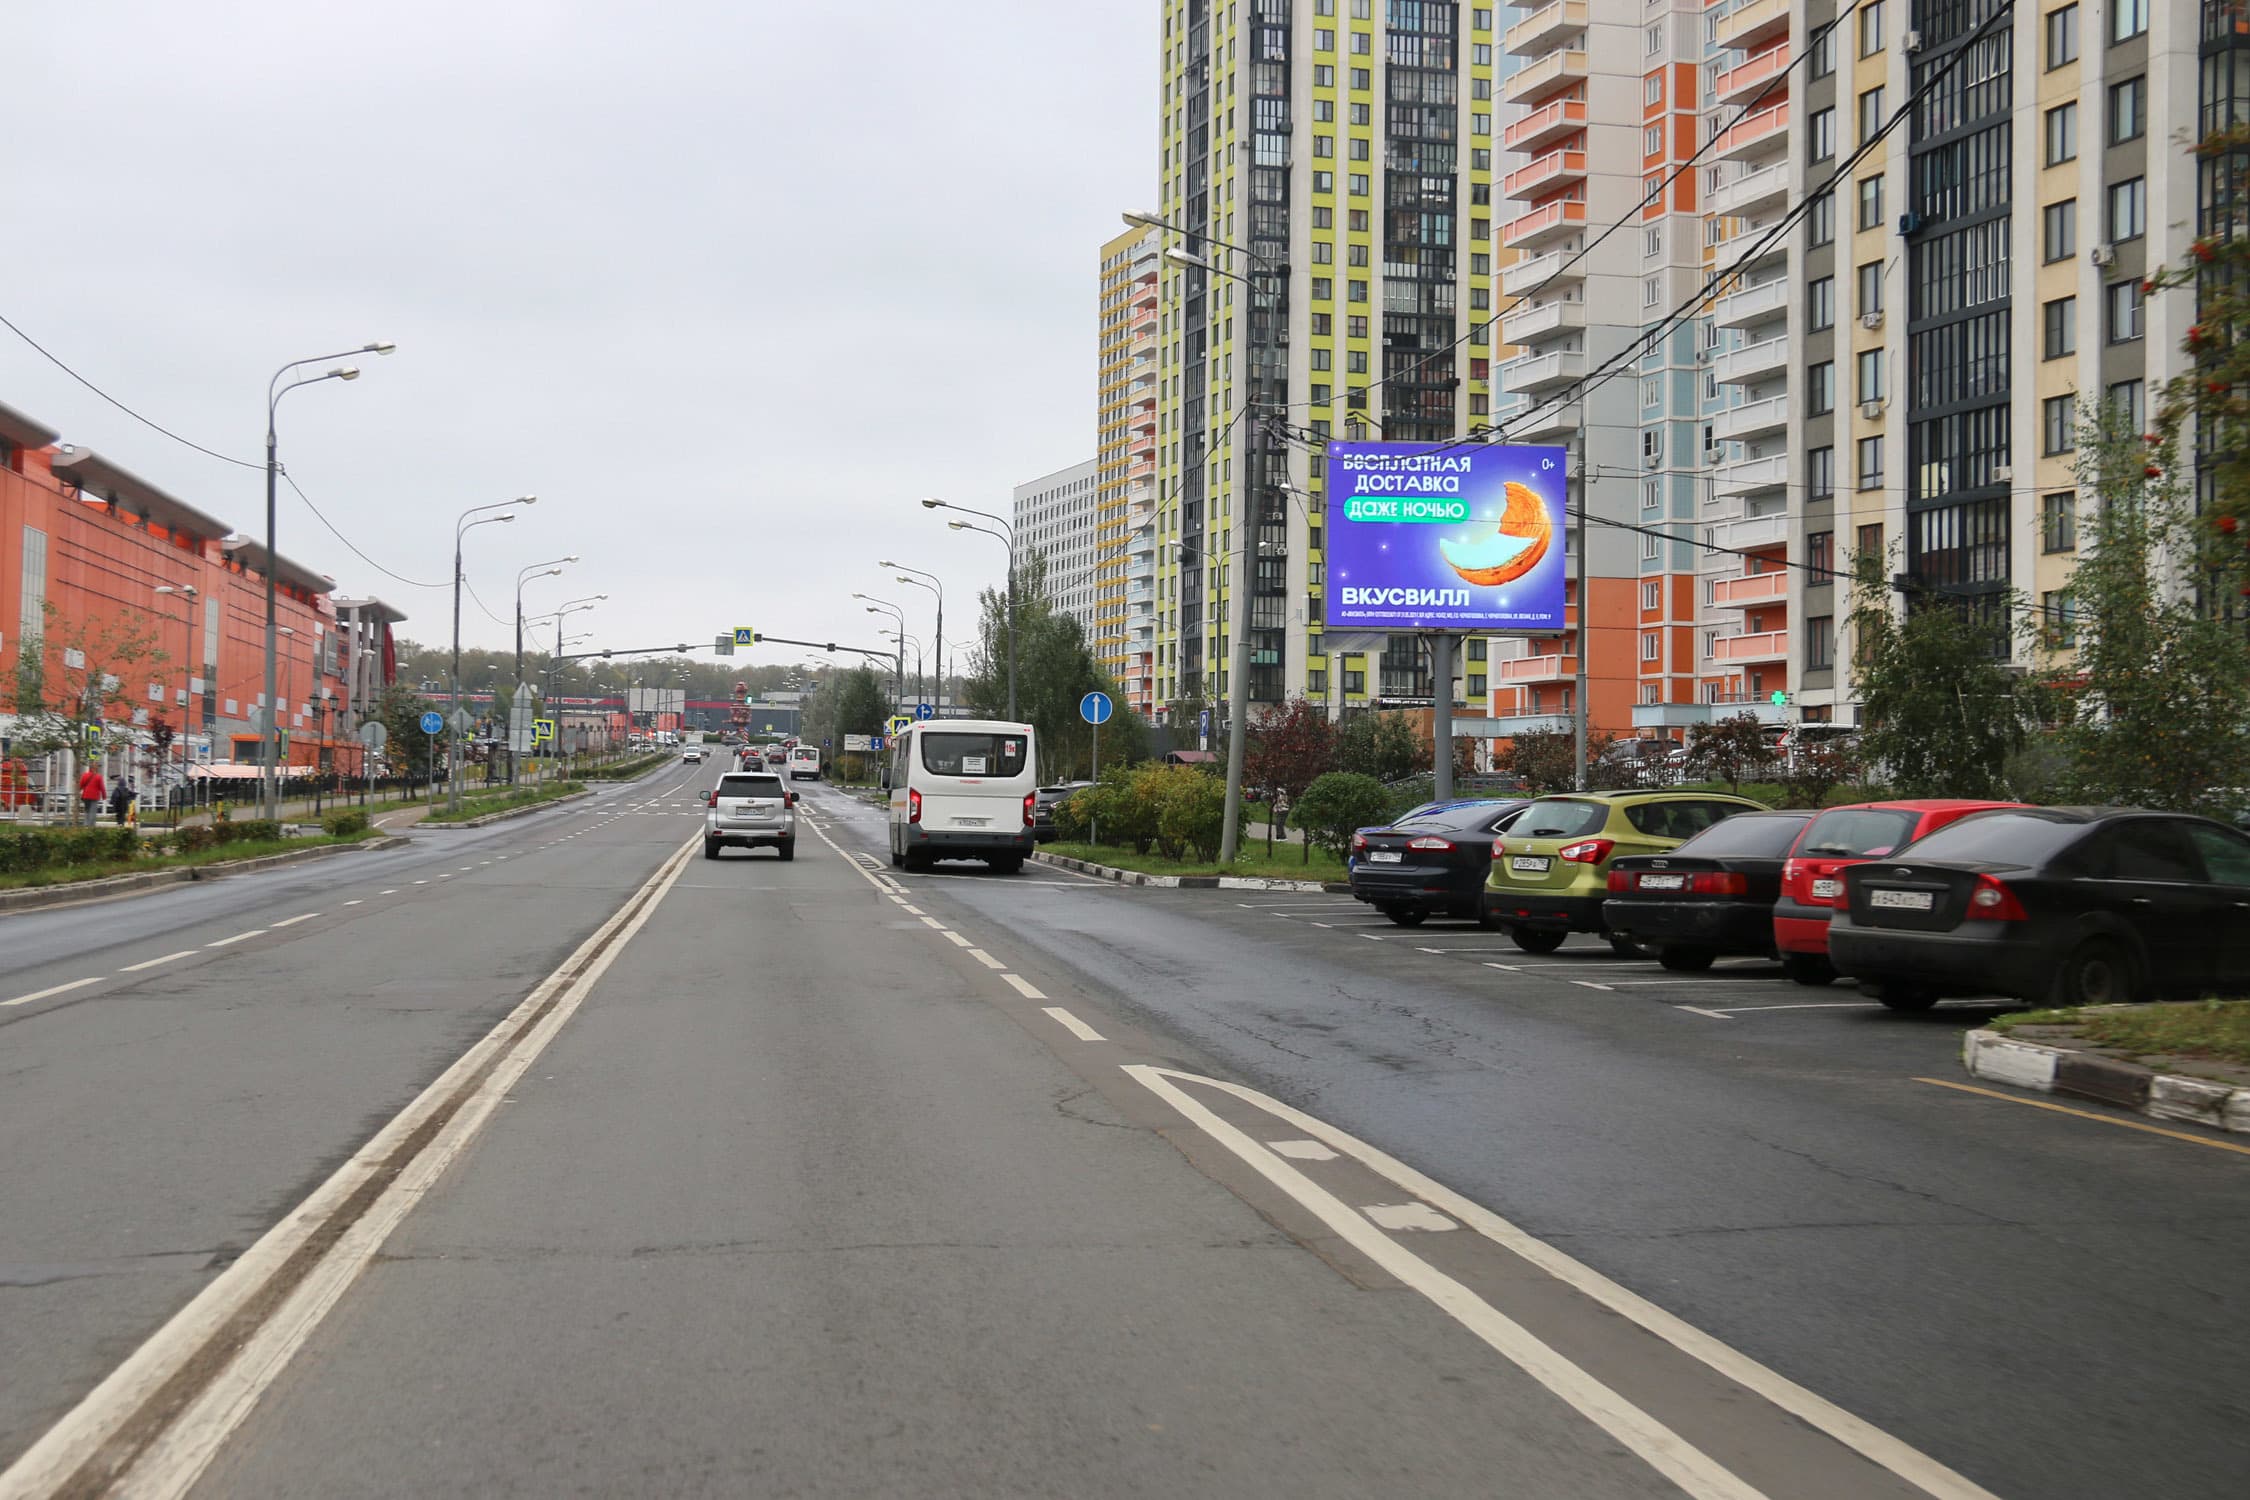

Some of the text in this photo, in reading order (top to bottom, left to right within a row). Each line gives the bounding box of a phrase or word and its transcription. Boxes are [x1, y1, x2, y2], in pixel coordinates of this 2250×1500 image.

[1542, 458, 1555, 470] 0+
[1355, 475, 1459, 493] ДОСТАВКА
[1349, 501, 1465, 519] ДАЖЕ НОЧЬЮ
[1341, 587, 1470, 606] ВКУСВИЛЛ
